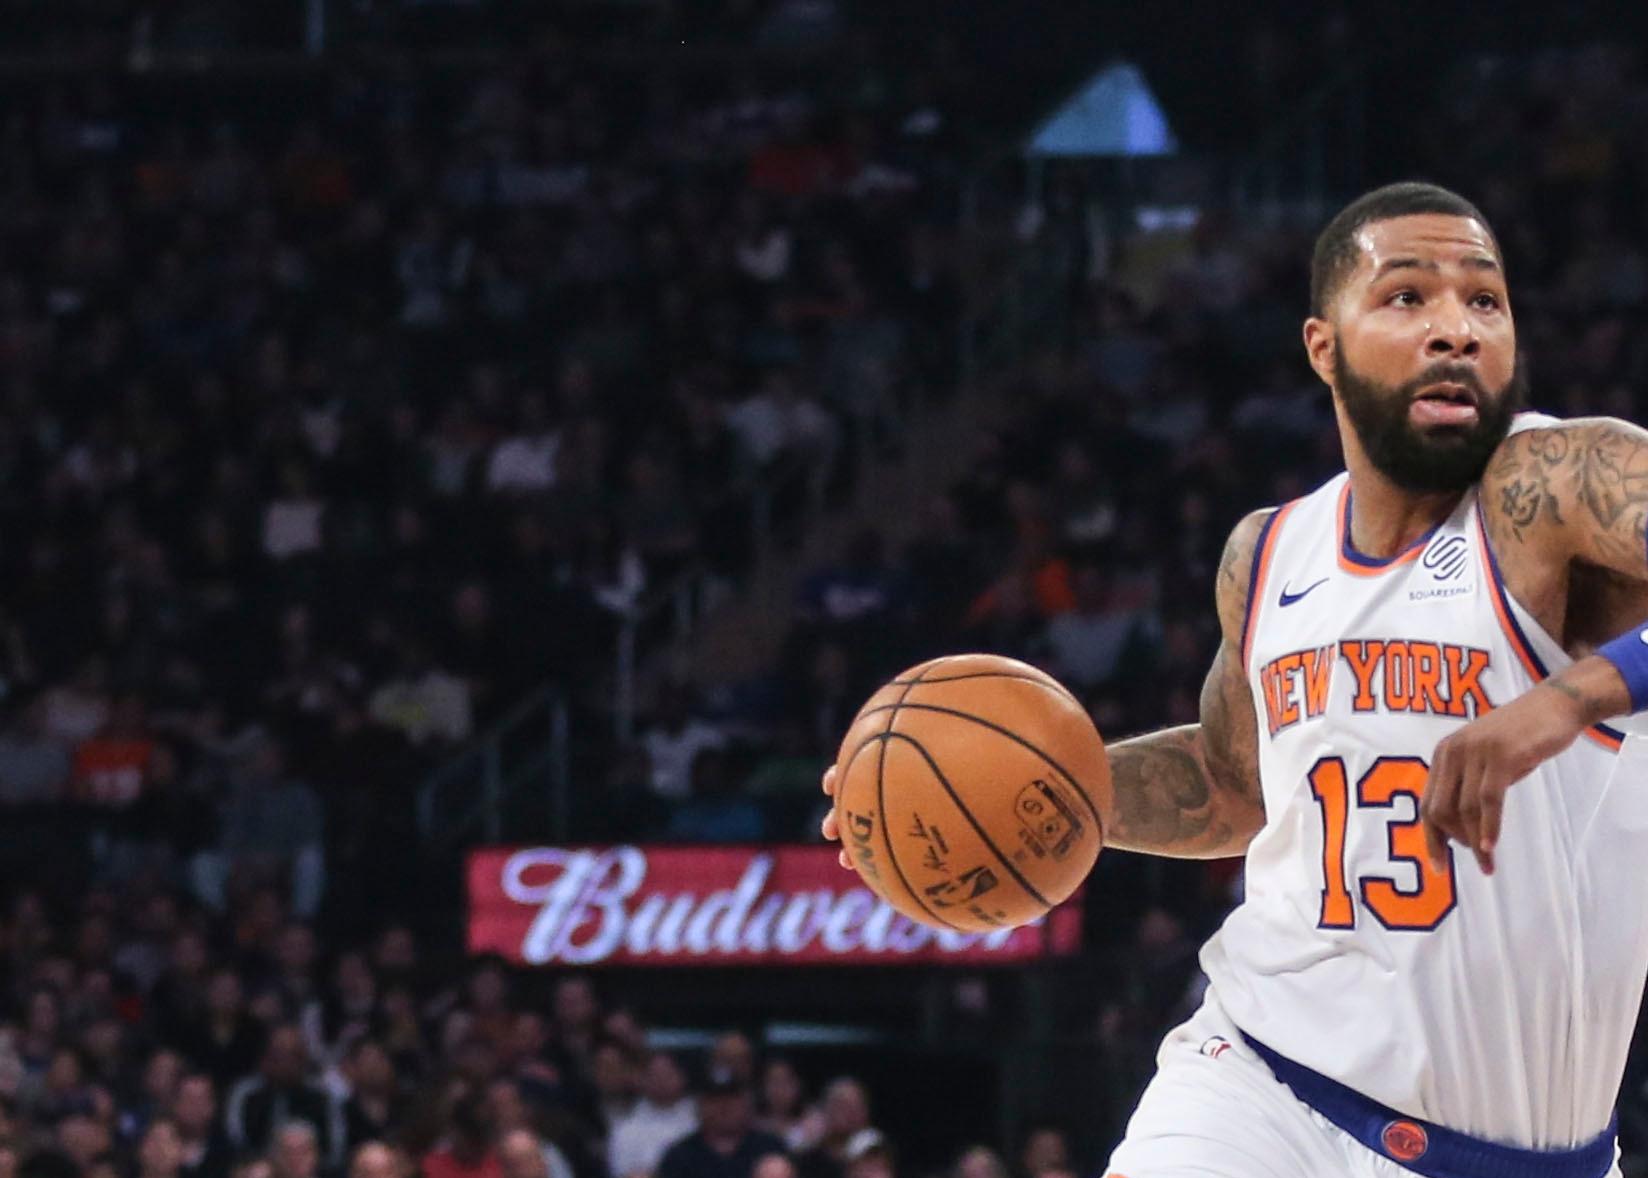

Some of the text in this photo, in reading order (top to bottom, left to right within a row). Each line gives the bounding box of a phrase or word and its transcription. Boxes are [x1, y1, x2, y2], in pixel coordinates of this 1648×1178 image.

[1261, 640, 1498, 740] NEW YORK
[1307, 756, 1458, 932] 13
